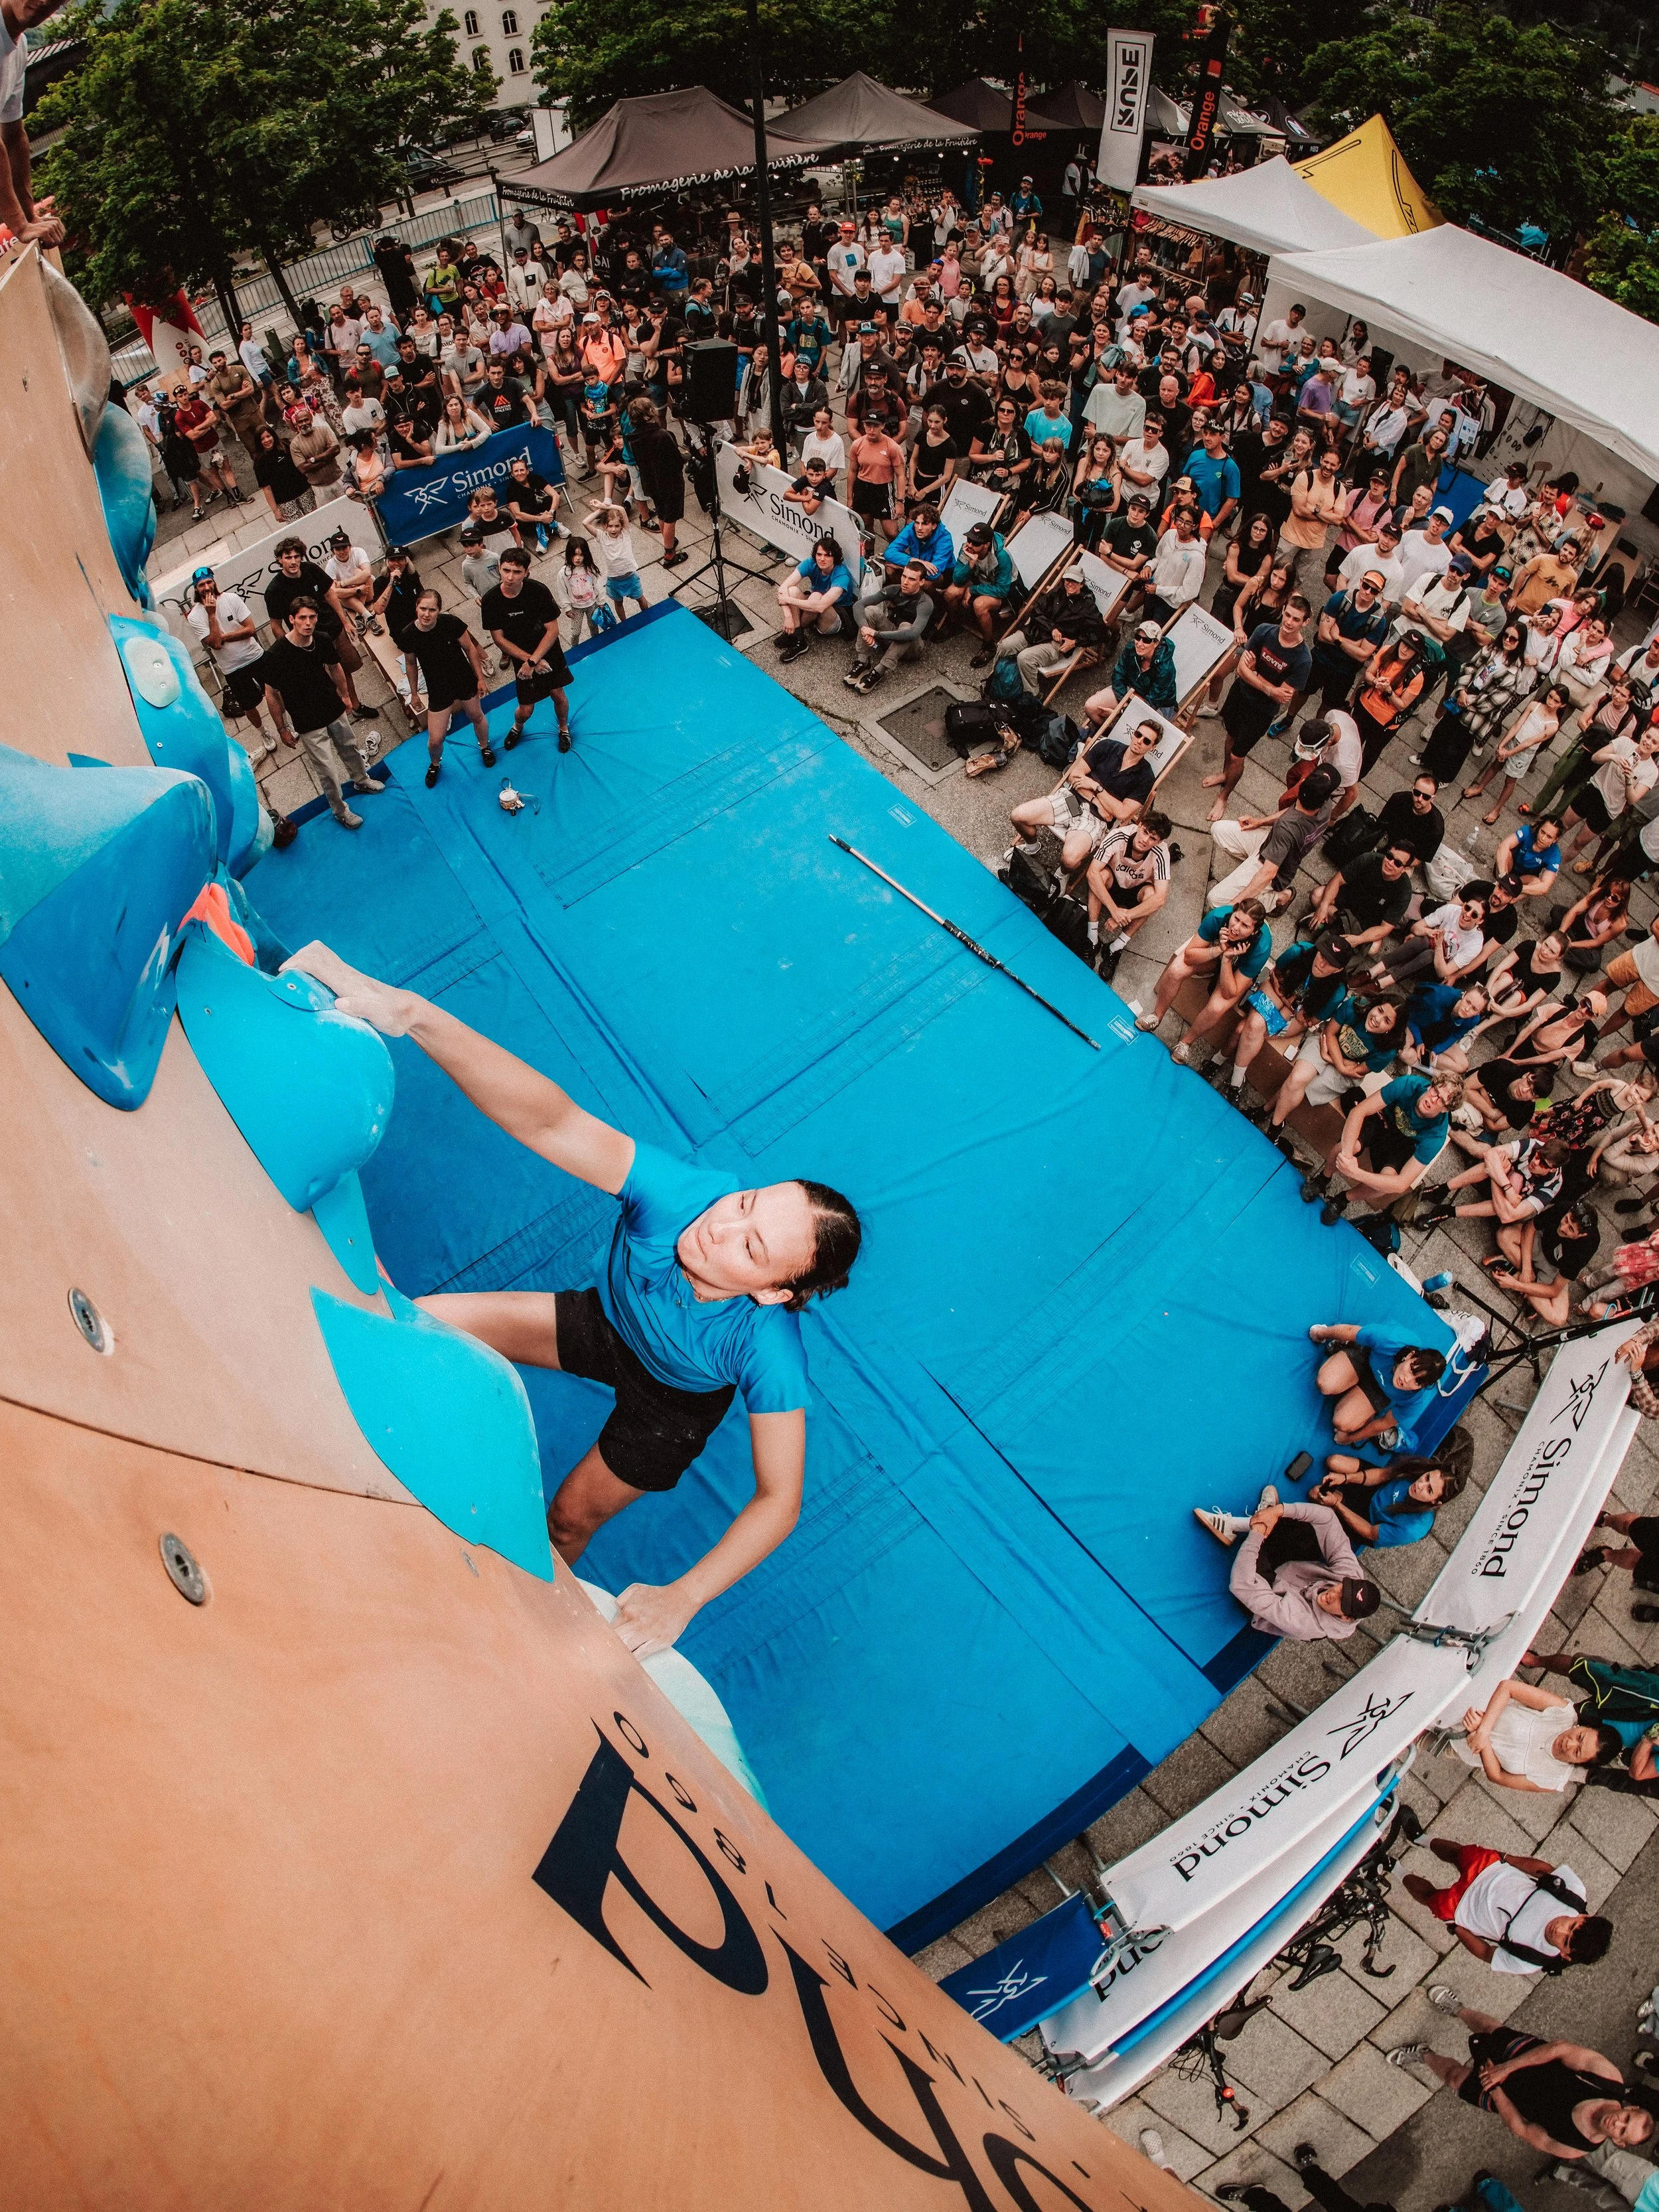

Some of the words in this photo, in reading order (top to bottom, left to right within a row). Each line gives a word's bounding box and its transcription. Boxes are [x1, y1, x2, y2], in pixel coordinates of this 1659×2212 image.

[1190, 91, 1215, 151] Orange
[1025, 131, 1047, 141] range
[620, 171, 710, 200] Fromagerie
[713, 169, 733, 181] de
[734, 165, 754, 177] la
[766, 153, 819, 170] ruitière
[502, 186, 532, 199] Fromagerie
[531, 190, 539, 200] de
[539, 191, 547, 202] la
[452, 446, 533, 492] Simond
[500, 475, 514, 483] SINC
[770, 493, 834, 539] Simond
[964, 503, 987, 517] Simond
[771, 515, 799, 534] CHAMONIX
[1048, 520, 1071, 535] Simond
[1089, 581, 1112, 599] Simond
[1201, 623, 1226, 644] Simond
[1116, 864, 1144, 879] adidas
[1512, 1441, 1545, 1499] CHAMONIX
[1479, 1438, 1573, 1578] Simond
[1487, 1514, 1508, 1545] SINCE
[1471, 1550, 1489, 1575] 1860
[1249, 1750, 1311, 1803] CHAMONIX
[613, 1710, 788, 1921] 1860
[1171, 1755, 1331, 1883] Simond
[1200, 1812, 1235, 1840] SINCE
[1169, 1842, 1198, 1862] 1860
[821, 1938, 1036, 2142] SINCE
